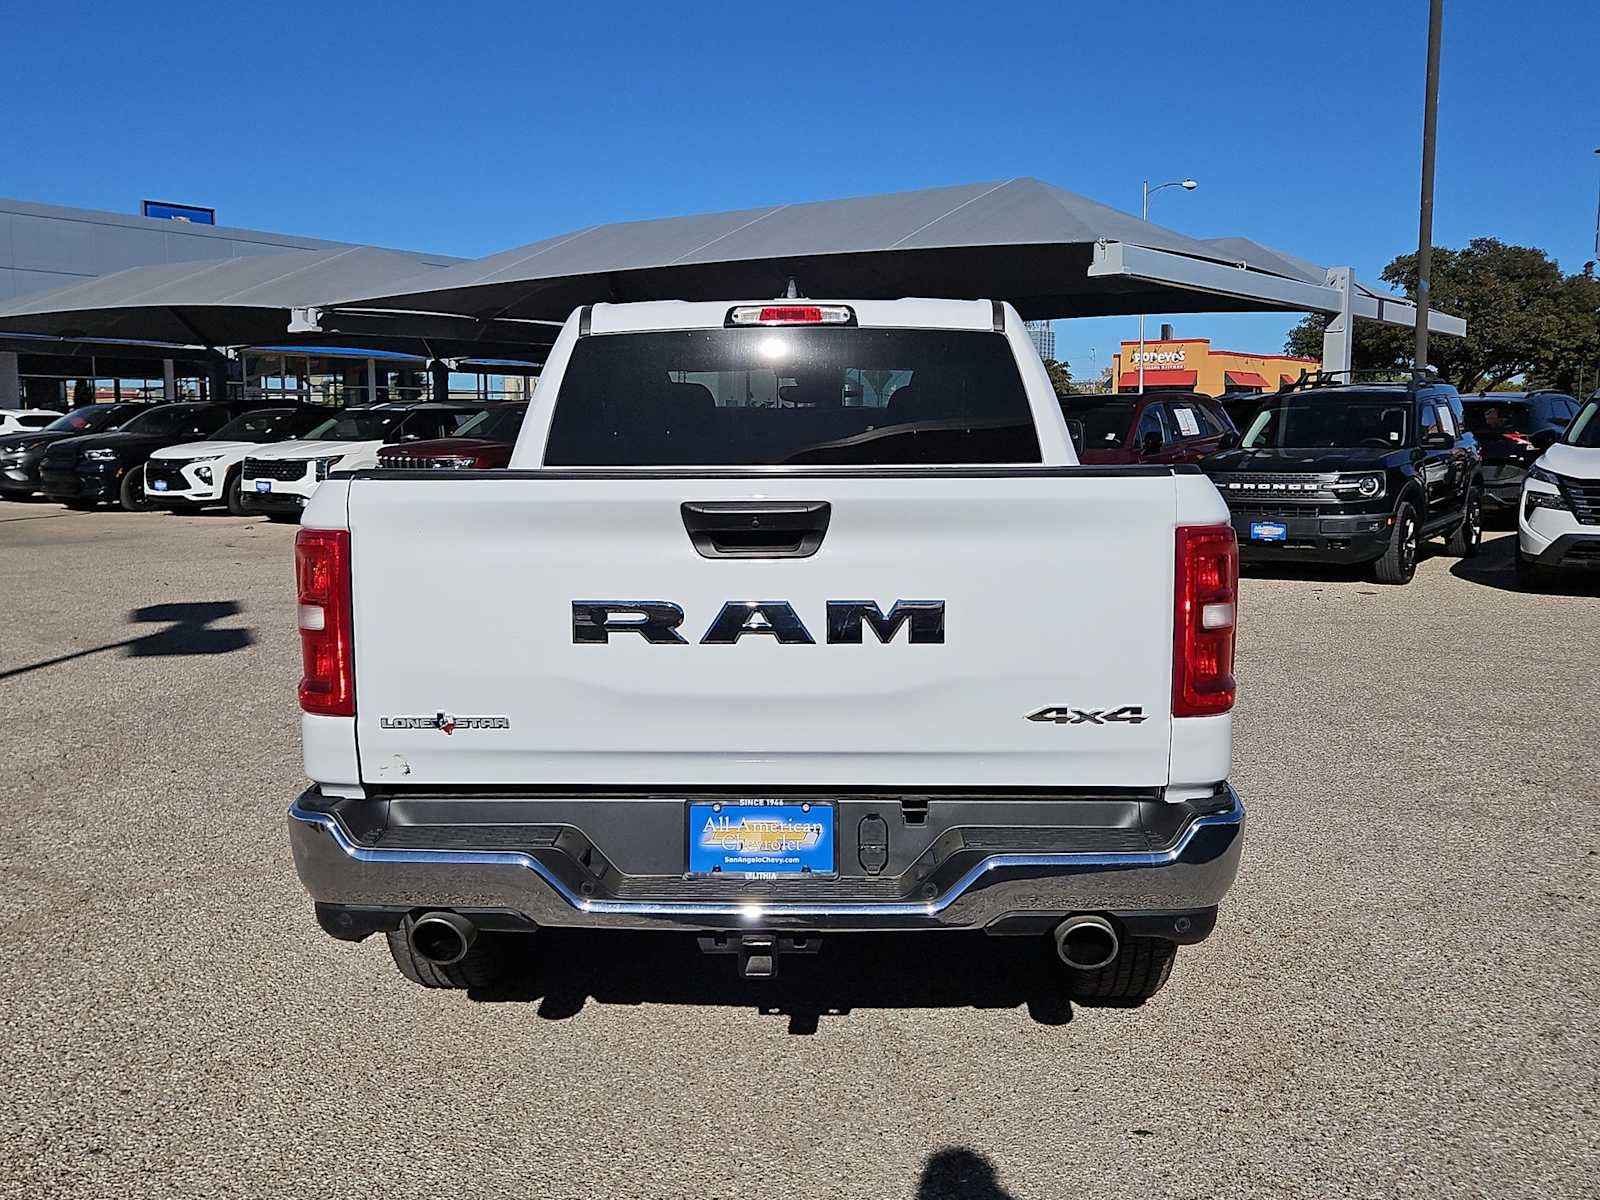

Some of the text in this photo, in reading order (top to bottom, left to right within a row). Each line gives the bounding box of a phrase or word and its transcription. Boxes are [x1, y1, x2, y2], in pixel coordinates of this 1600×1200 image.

[572, 600, 946, 644] RAM
[380, 717, 510, 729] LONE STAR
[702, 815, 824, 833] All American
[721, 834, 802, 851] Chevrolet
[724, 856, 800, 865] SanAngeloChevy.com
